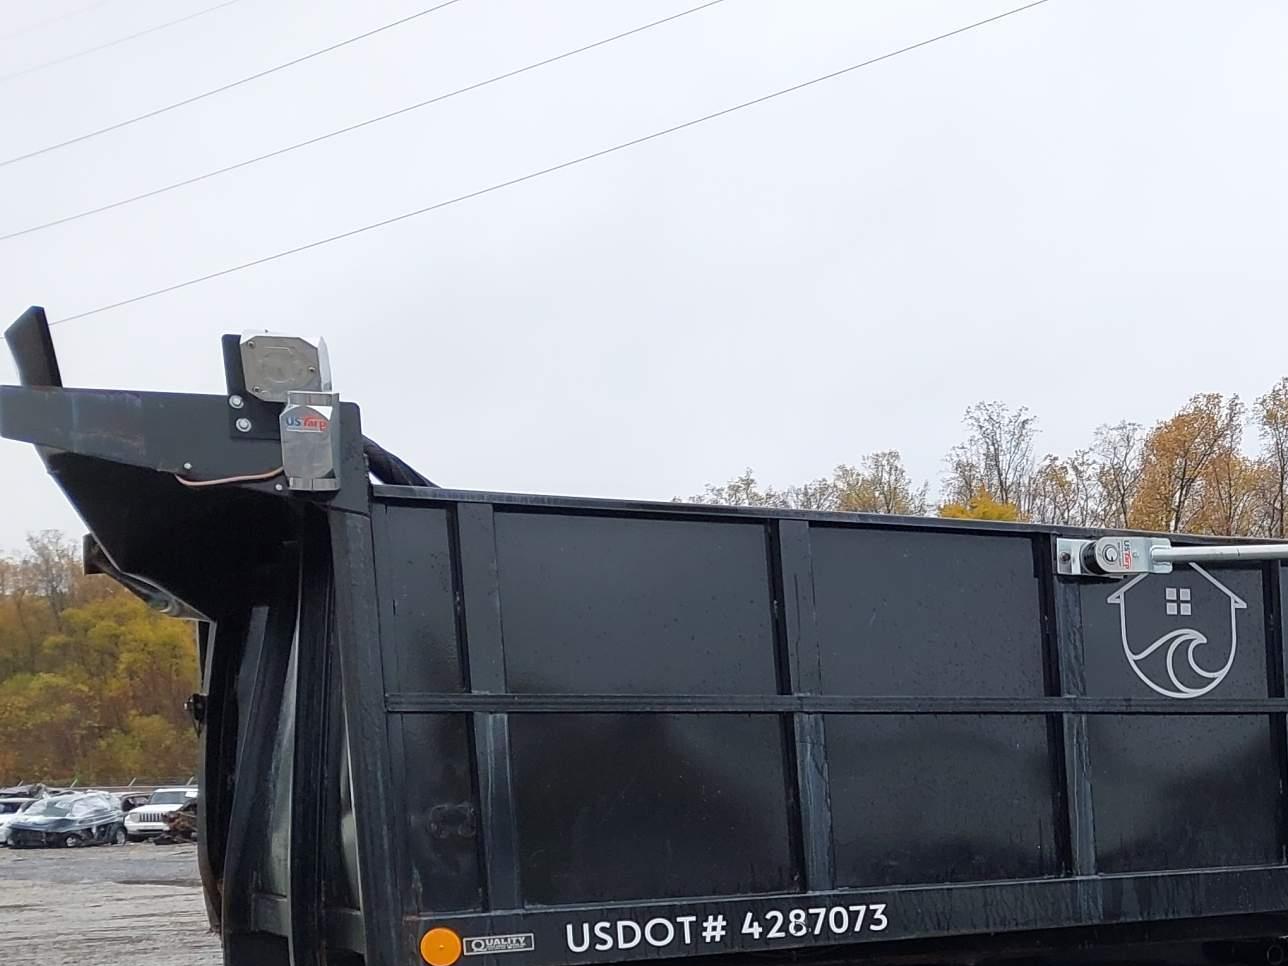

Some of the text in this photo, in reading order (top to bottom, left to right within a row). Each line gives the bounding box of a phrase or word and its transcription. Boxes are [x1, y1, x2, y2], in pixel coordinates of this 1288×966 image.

[471, 936, 526, 952] QUALITY
[565, 903, 889, 953] USDOT# 4287073
